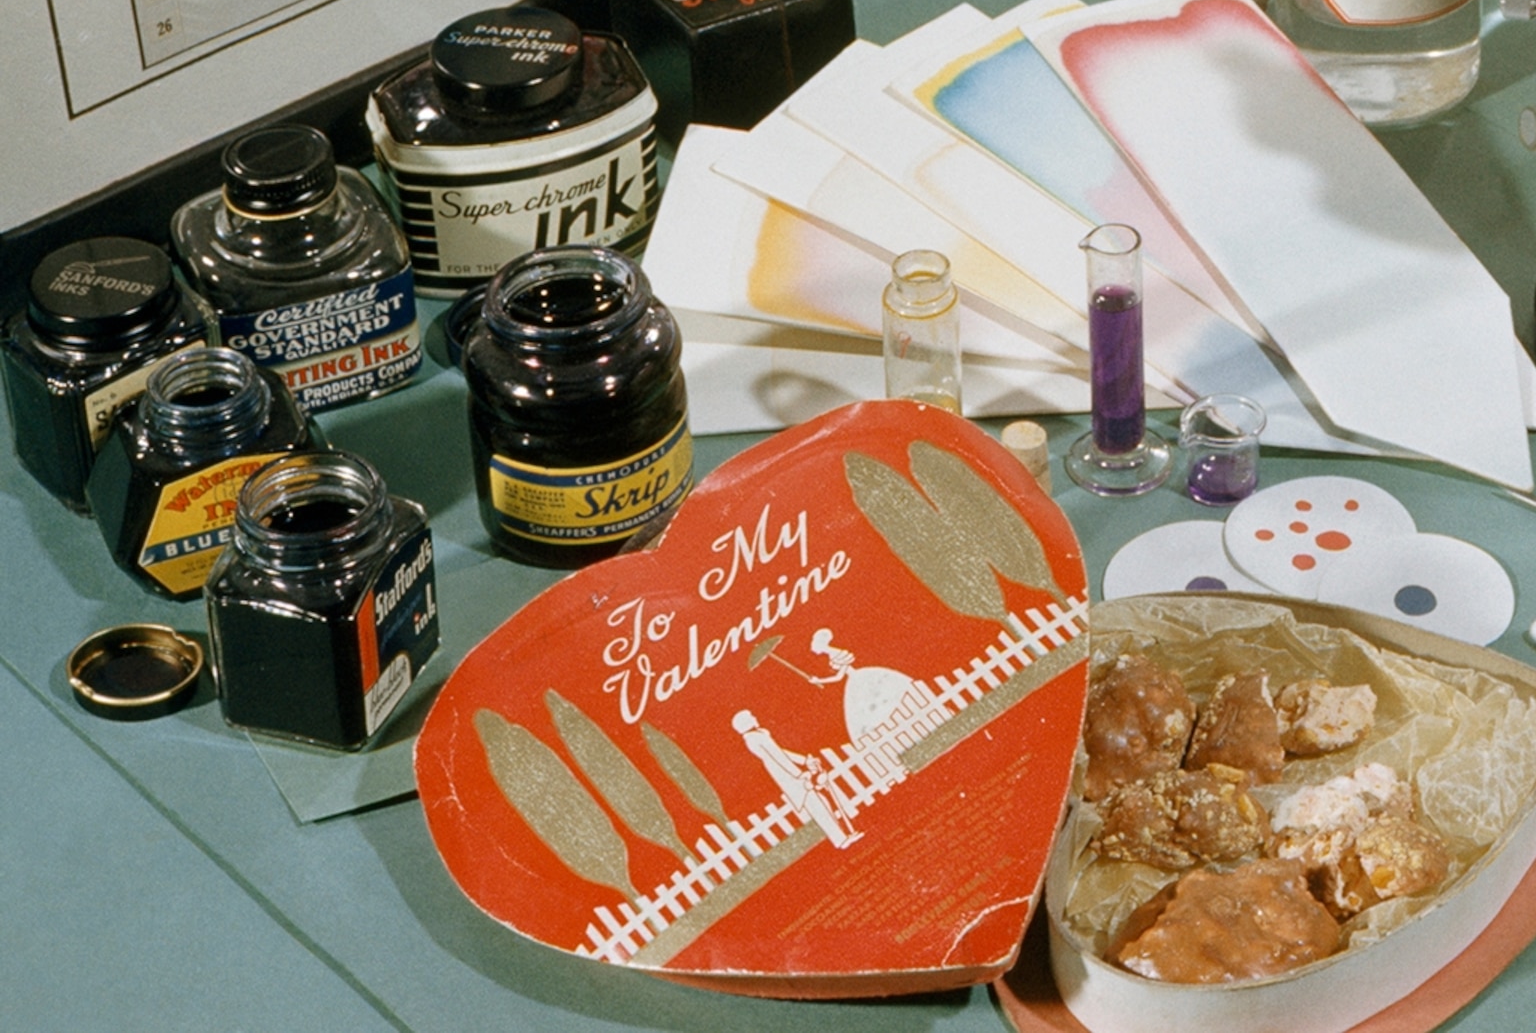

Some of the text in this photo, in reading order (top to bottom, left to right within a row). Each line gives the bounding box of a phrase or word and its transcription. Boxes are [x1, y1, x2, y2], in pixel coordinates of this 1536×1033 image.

[156, 18, 173, 37] 26
[474, 25, 552, 40] PARKER
[511, 50, 550, 64] ink
[534, 157, 638, 251] ink
[48, 277, 90, 296] INKS
[59, 270, 155, 296] SANFORD'S
[447, 264, 471, 274] FOR
[228, 293, 404, 349] GOVERNMENT
[254, 283, 380, 331] Certified
[254, 316, 390, 359] STANDARD
[285, 335, 361, 361] QUALITY
[361, 335, 411, 367] INK
[303, 373, 375, 401] PRODUCTS
[575, 447, 666, 486] CHEMOPURE
[575, 468, 670, 519] Skrip
[528, 507, 660, 538] SHEAFFER'S PERMANENT
[375, 538, 433, 626] Stafford's
[603, 503, 807, 667] To My
[414, 583, 436, 635] ink
[603, 550, 851, 725] Valentine
